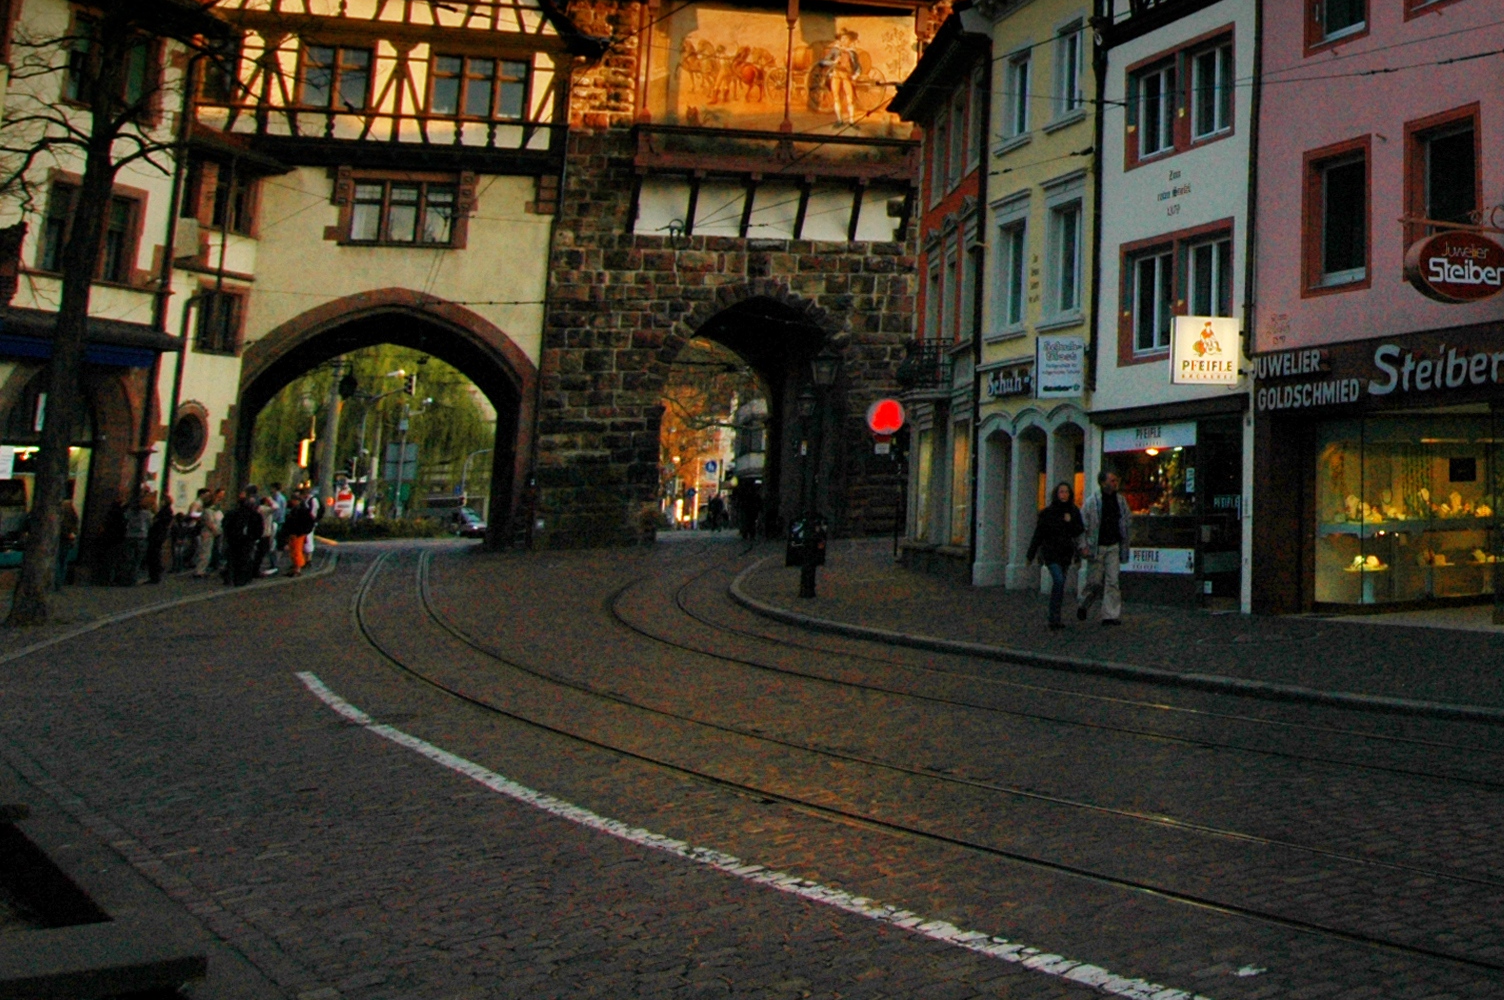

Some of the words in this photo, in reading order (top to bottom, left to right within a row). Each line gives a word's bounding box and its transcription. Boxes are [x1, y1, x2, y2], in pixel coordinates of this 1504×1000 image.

[1440, 240, 1490, 260] Juwelier
[1181, 359, 1233, 372] PFEIFLE
[1249, 348, 1321, 381] JUWELIER
[1256, 377, 1361, 411] GOLDSCHMIED
